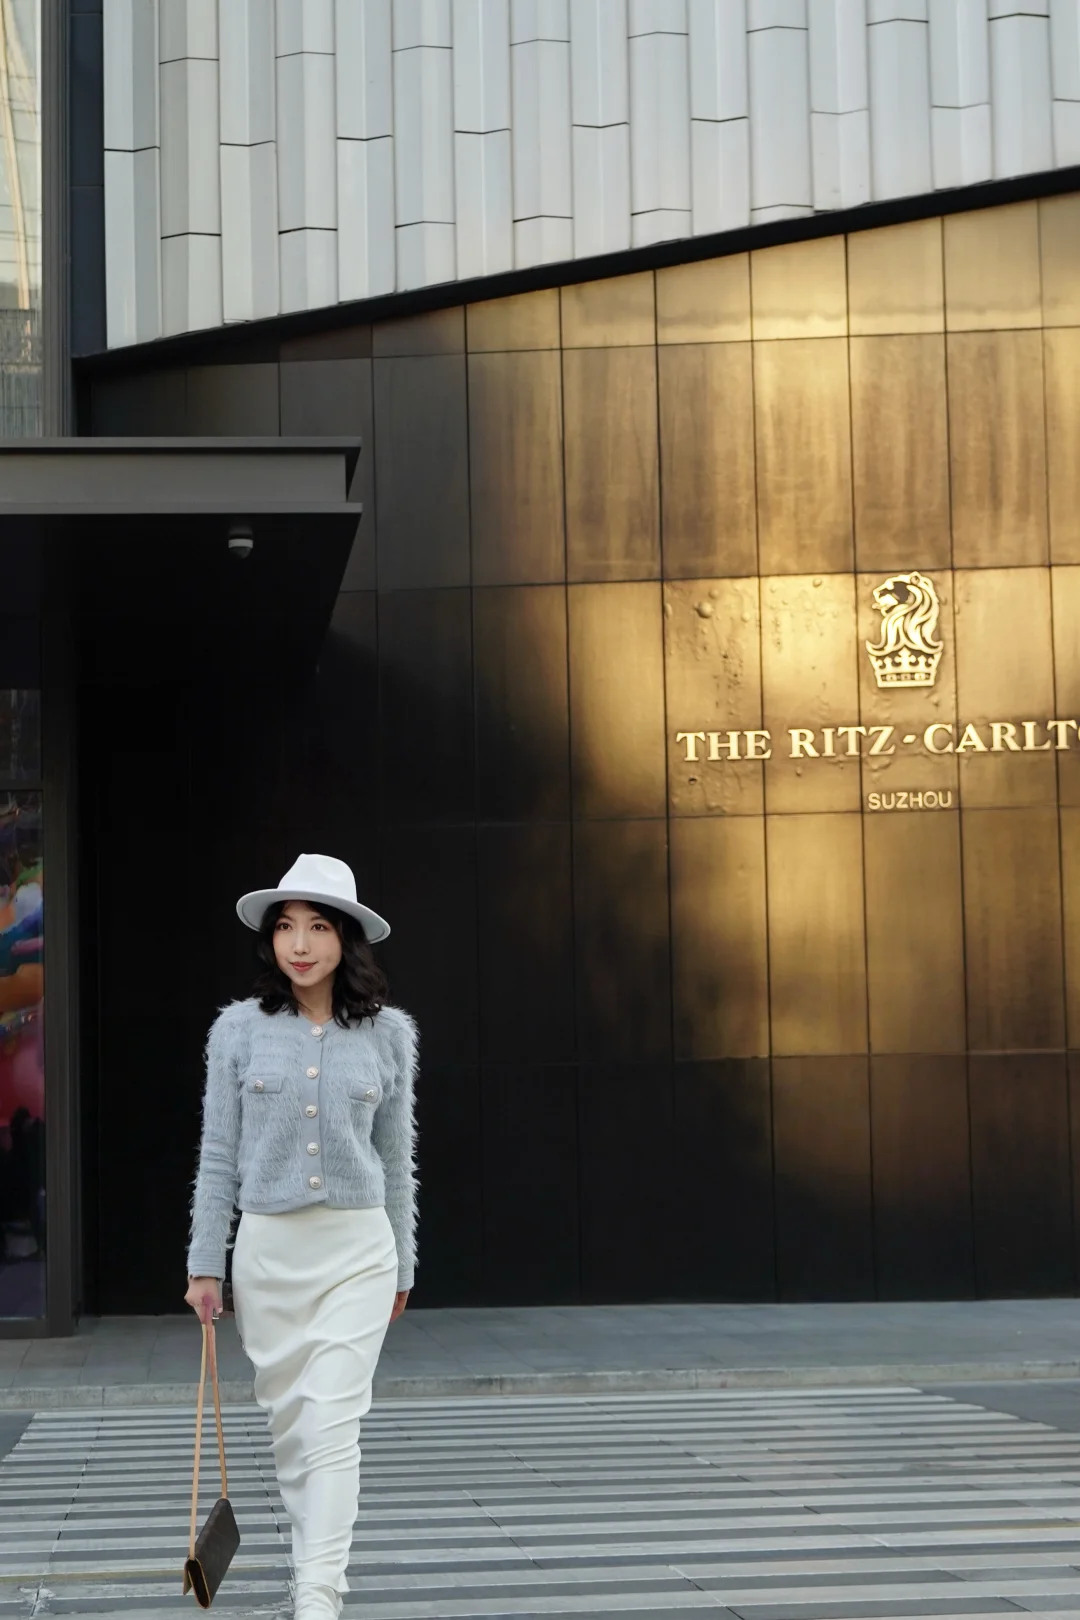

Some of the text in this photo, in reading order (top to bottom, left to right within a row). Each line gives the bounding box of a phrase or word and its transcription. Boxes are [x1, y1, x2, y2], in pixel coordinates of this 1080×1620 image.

[676, 719, 1080, 761] THE RITZ-CARLT
[868, 791, 952, 811] SUZHOU
